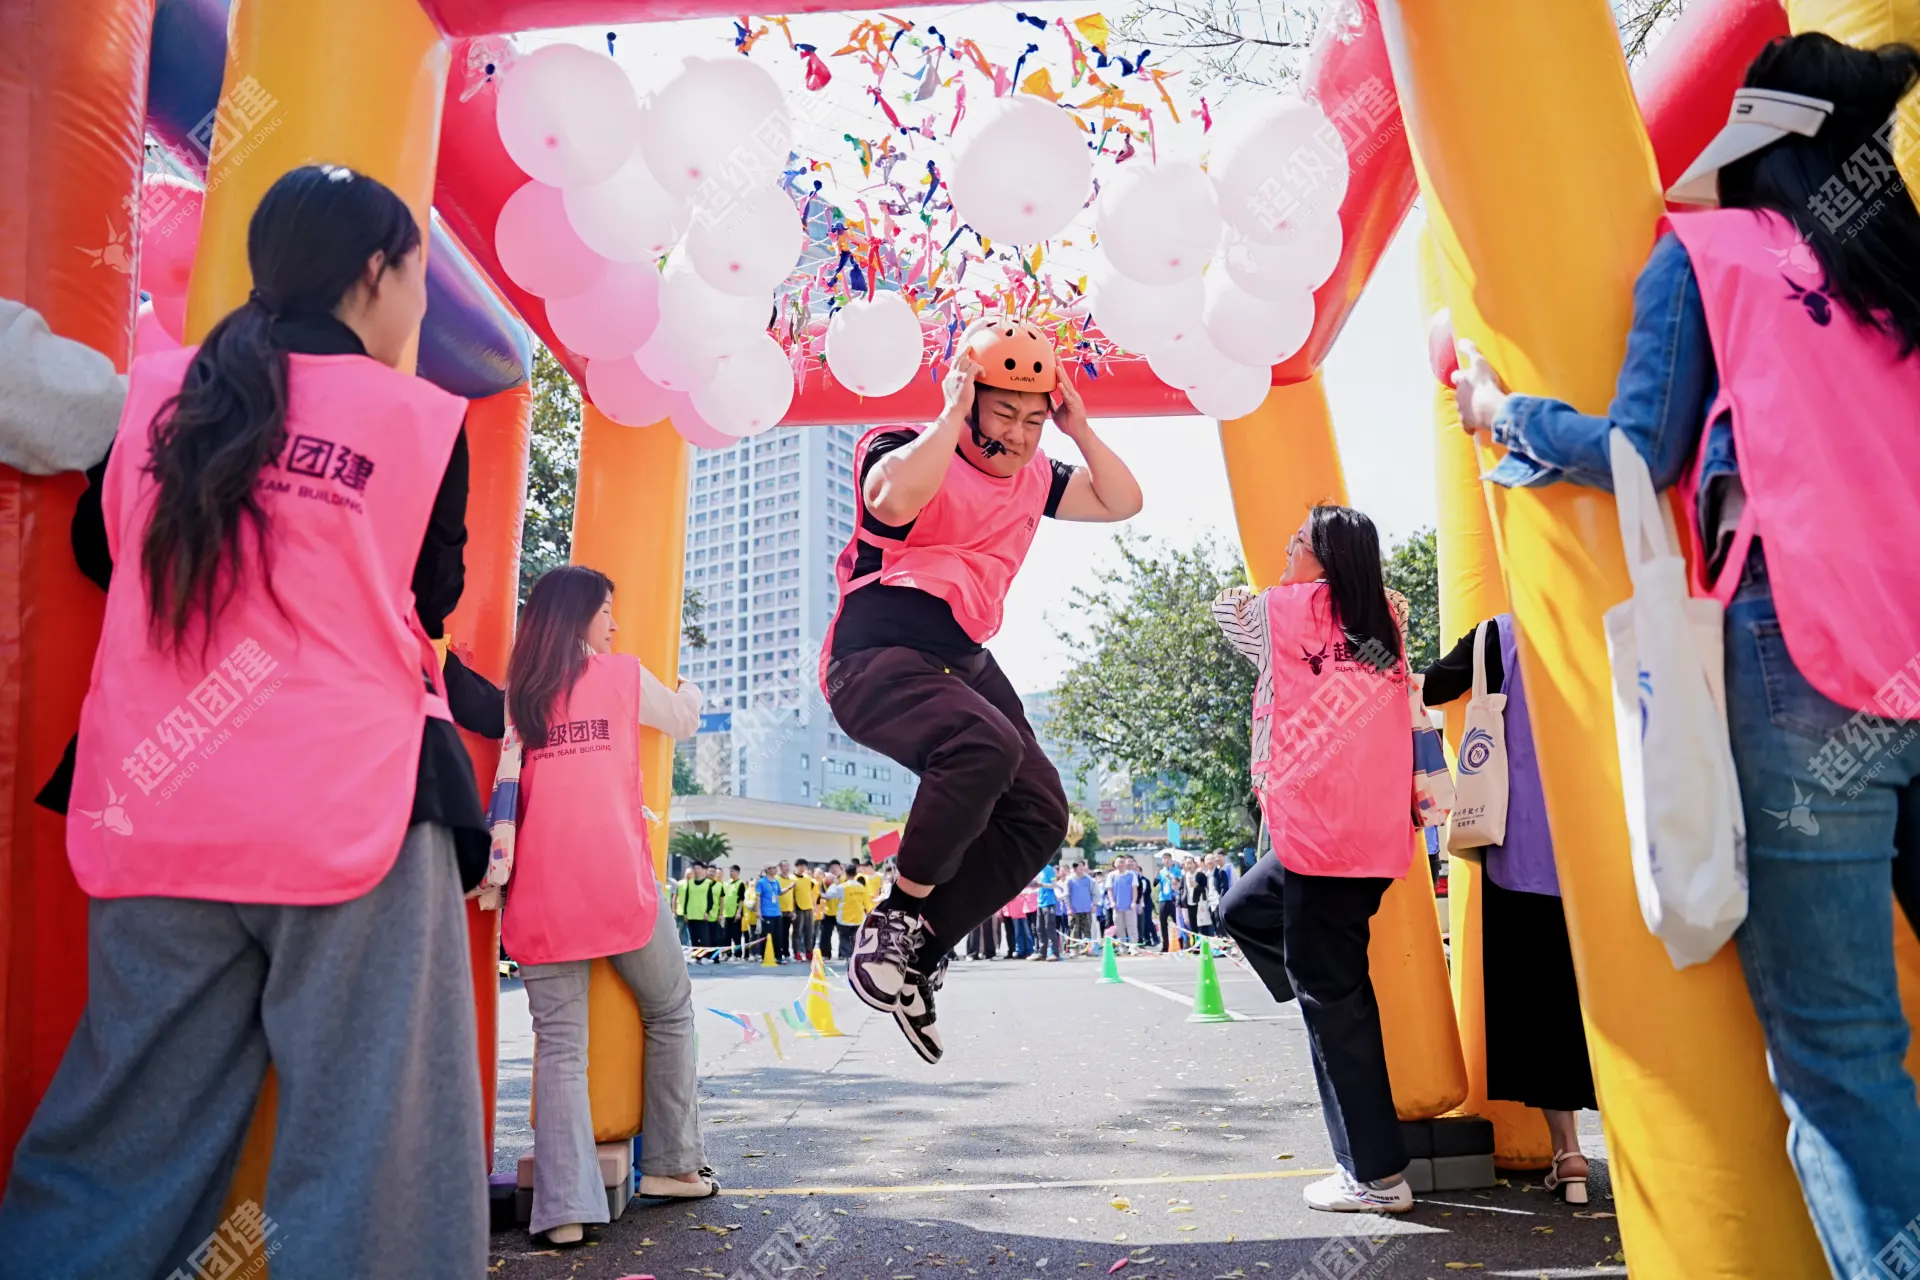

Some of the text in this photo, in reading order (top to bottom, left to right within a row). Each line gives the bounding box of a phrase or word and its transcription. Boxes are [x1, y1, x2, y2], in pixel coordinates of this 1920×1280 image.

[548, 718, 610, 747] 级团建
[557, 748, 576, 756] TEAM
[580, 744, 612, 755] BUILDING
